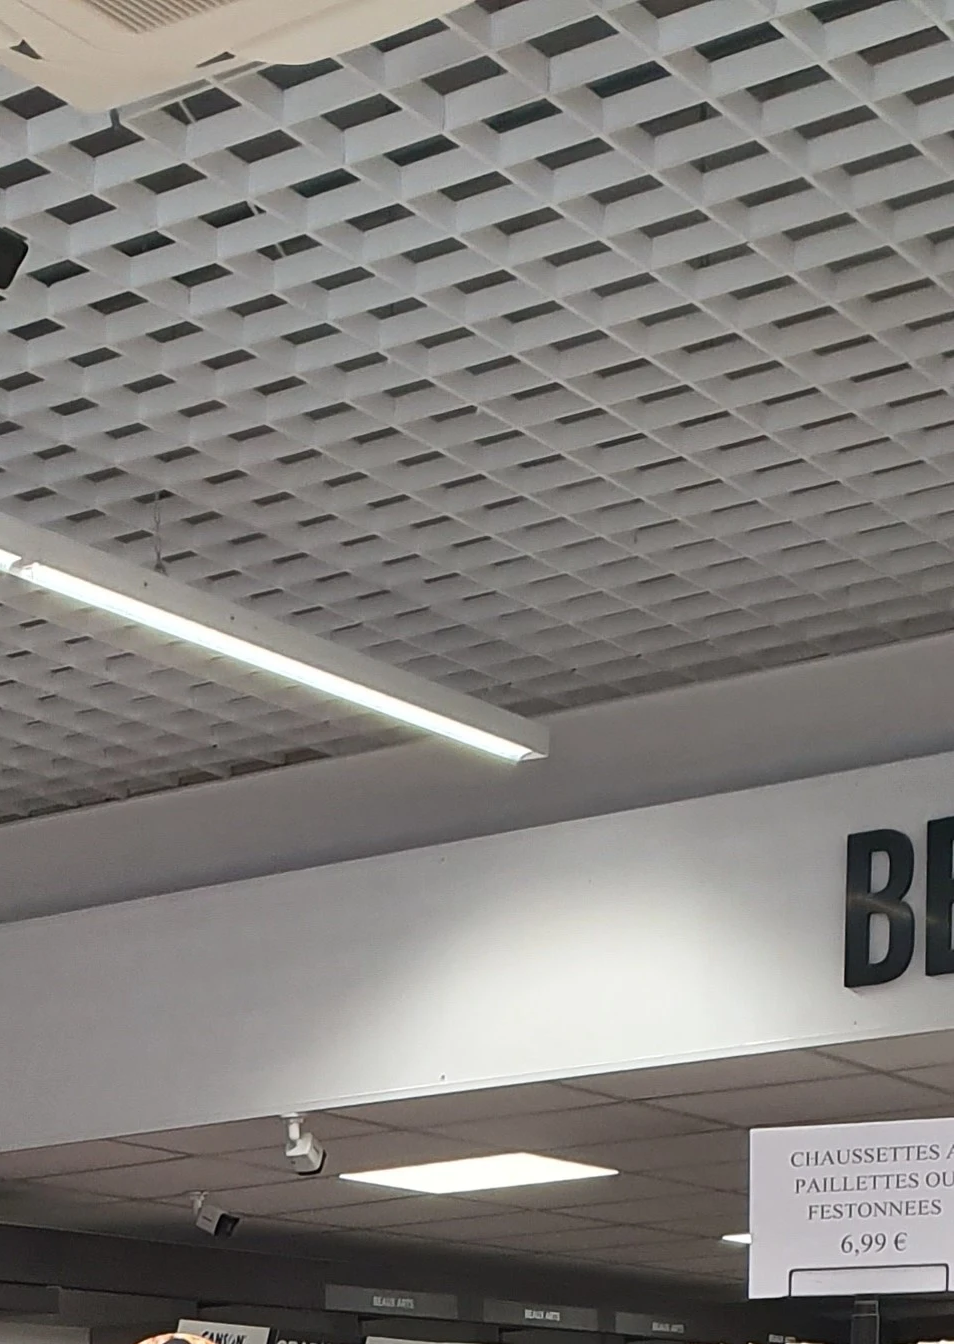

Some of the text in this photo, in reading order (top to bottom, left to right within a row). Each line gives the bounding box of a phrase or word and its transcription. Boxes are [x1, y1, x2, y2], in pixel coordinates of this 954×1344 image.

[790, 1143, 940, 1168] CHAUSSETTES
[795, 1171, 954, 1194] PAILLETTES OU
[808, 1199, 942, 1220] FESTONNEES
[841, 1232, 908, 1256] 6,99 €
